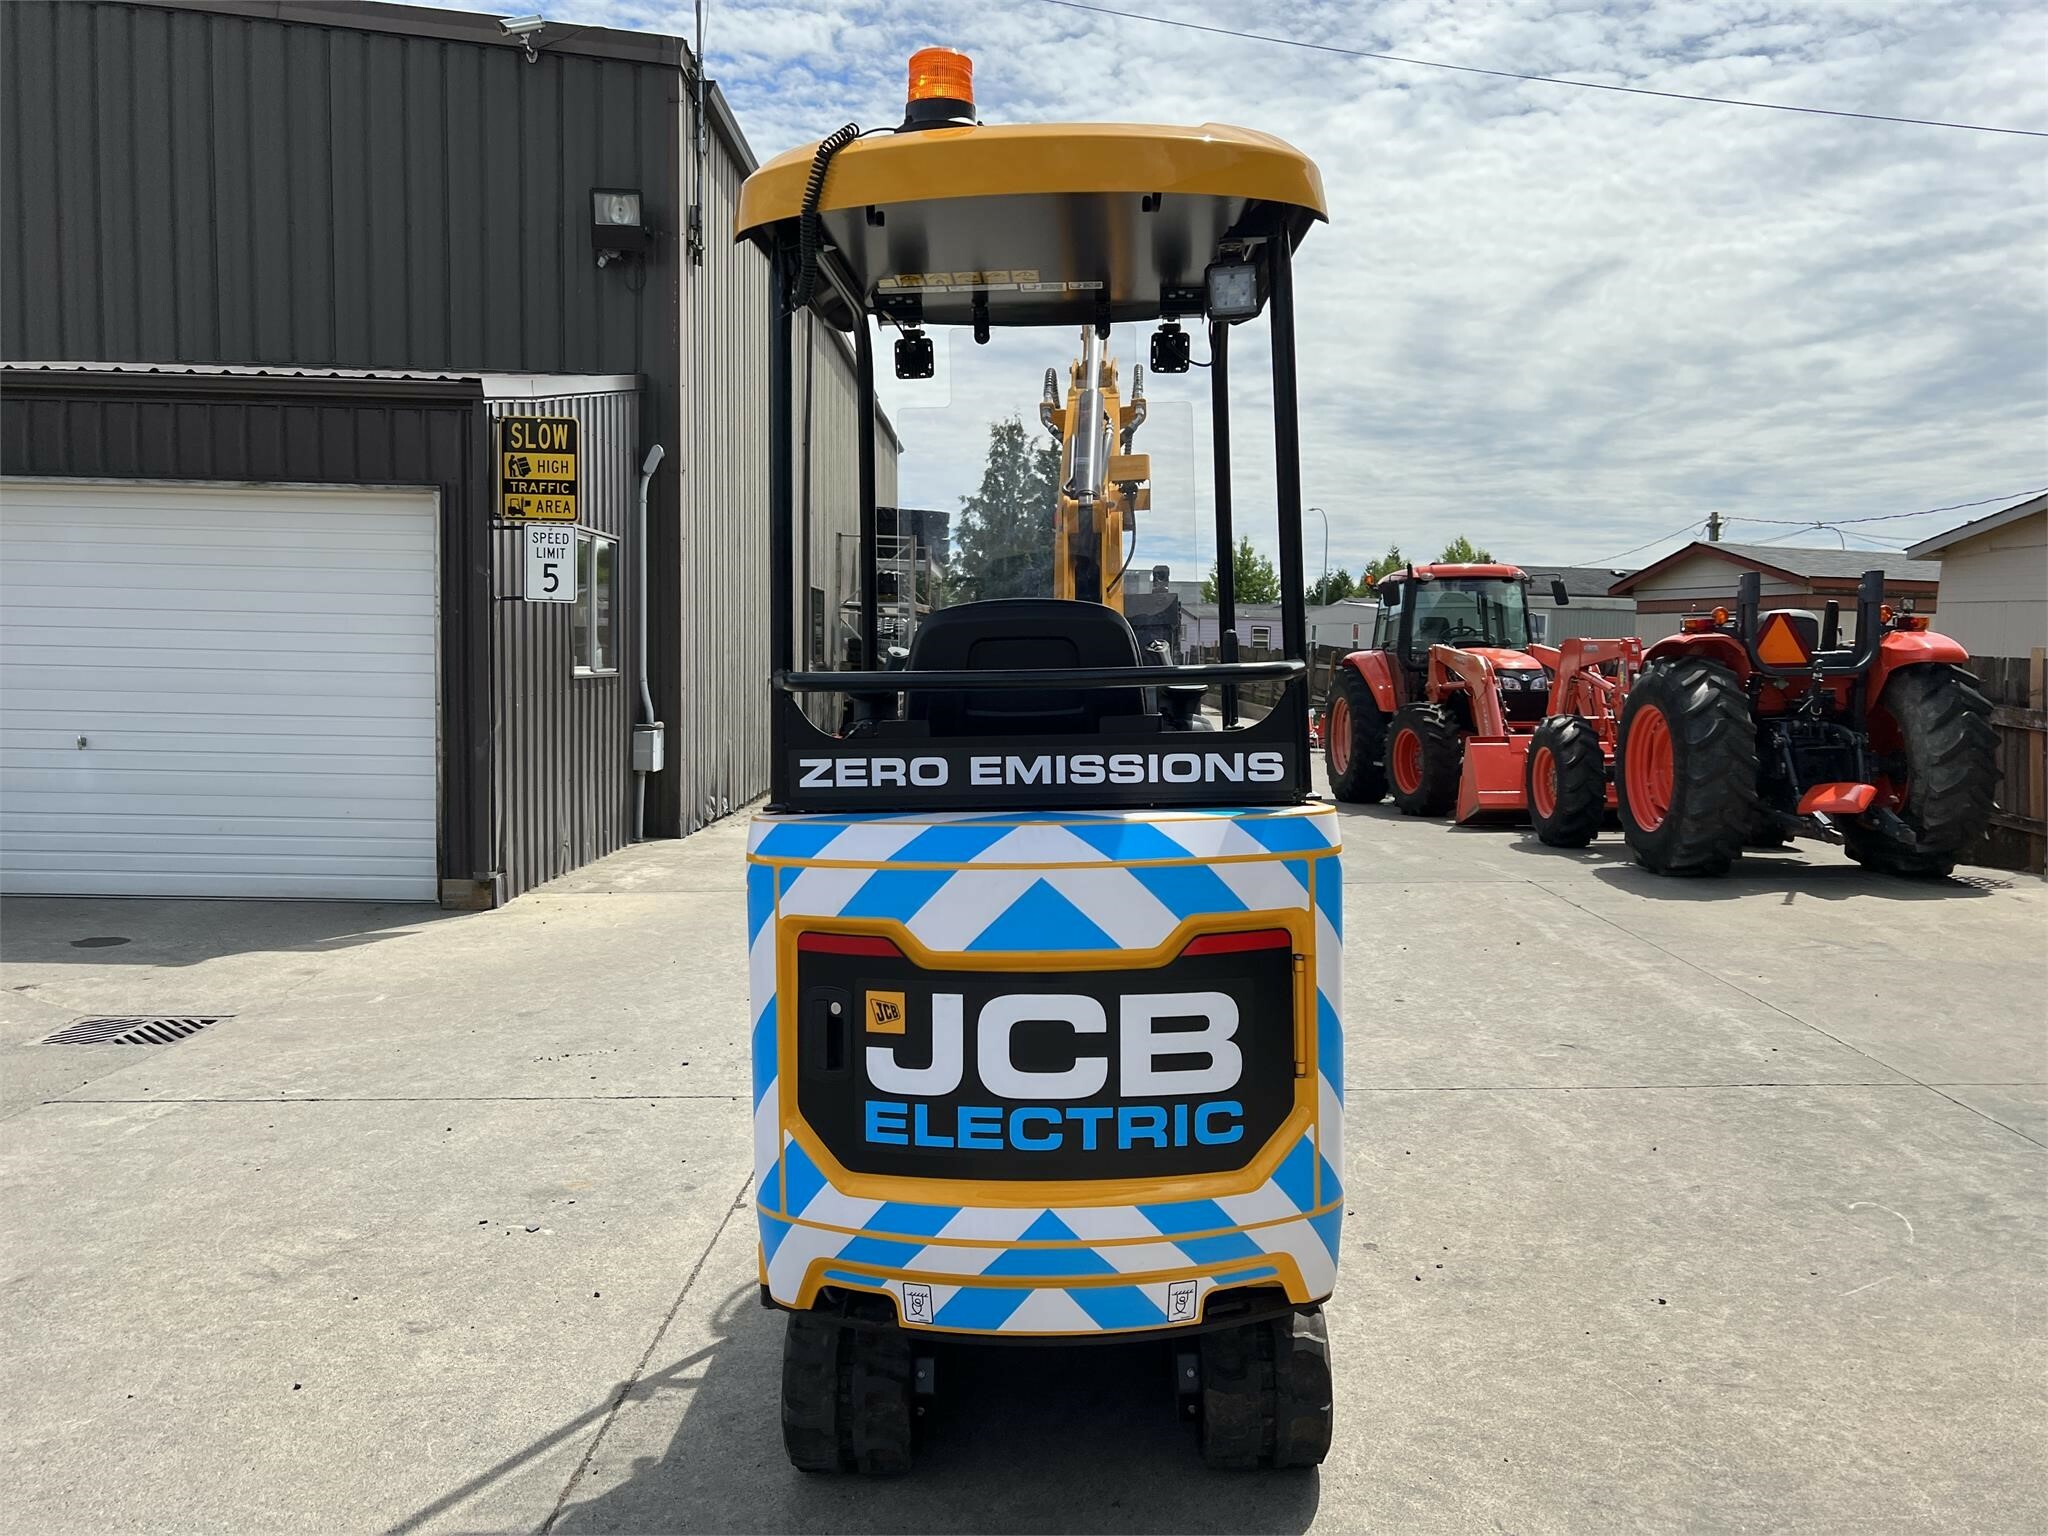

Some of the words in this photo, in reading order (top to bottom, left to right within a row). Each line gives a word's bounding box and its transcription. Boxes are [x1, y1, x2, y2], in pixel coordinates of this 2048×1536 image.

[511, 422, 568, 450] SLOW
[537, 460, 569, 474] HIGH
[510, 481, 570, 494] TRAFFIC
[536, 501, 571, 514] AREA
[532, 532, 569, 545] SPEED
[536, 547, 566, 559] LIMIT
[543, 563, 559, 592] 5
[799, 757, 949, 787] ZERO
[970, 752, 1285, 786] EMISSIONS
[876, 1001, 898, 1022] JCB
[865, 991, 1243, 1099] JCB
[865, 1100, 1245, 1151] ELECTRIC
